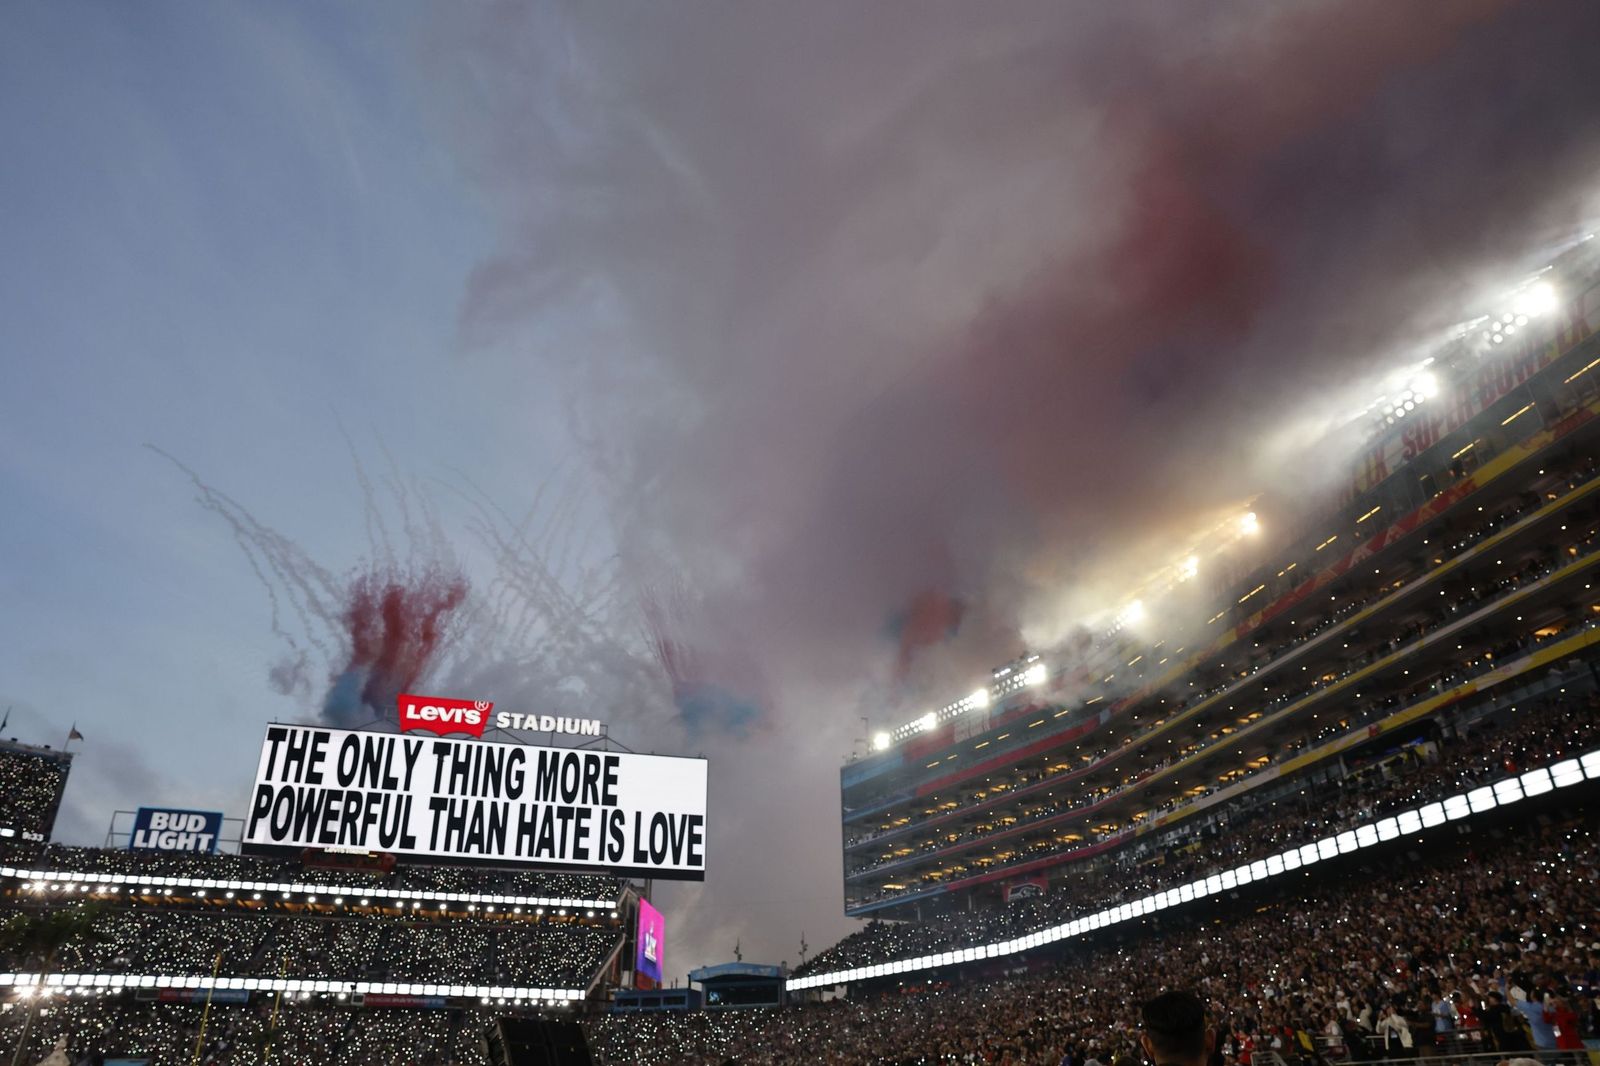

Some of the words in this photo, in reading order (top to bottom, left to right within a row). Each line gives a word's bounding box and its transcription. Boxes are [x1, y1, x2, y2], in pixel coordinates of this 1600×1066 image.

[496, 711, 600, 737] STADIUM
[266, 727, 330, 785] THE
[336, 733, 424, 793] ONLY
[432, 741, 526, 801] THING
[535, 750, 620, 807] MORE
[149, 811, 207, 833] BUD
[247, 784, 417, 850] POWERFUL
[428, 797, 510, 856] THAN
[515, 803, 592, 861] HATE
[599, 808, 626, 863] IS
[633, 811, 704, 867] LOVE
[133, 829, 214, 851] LIGHT
